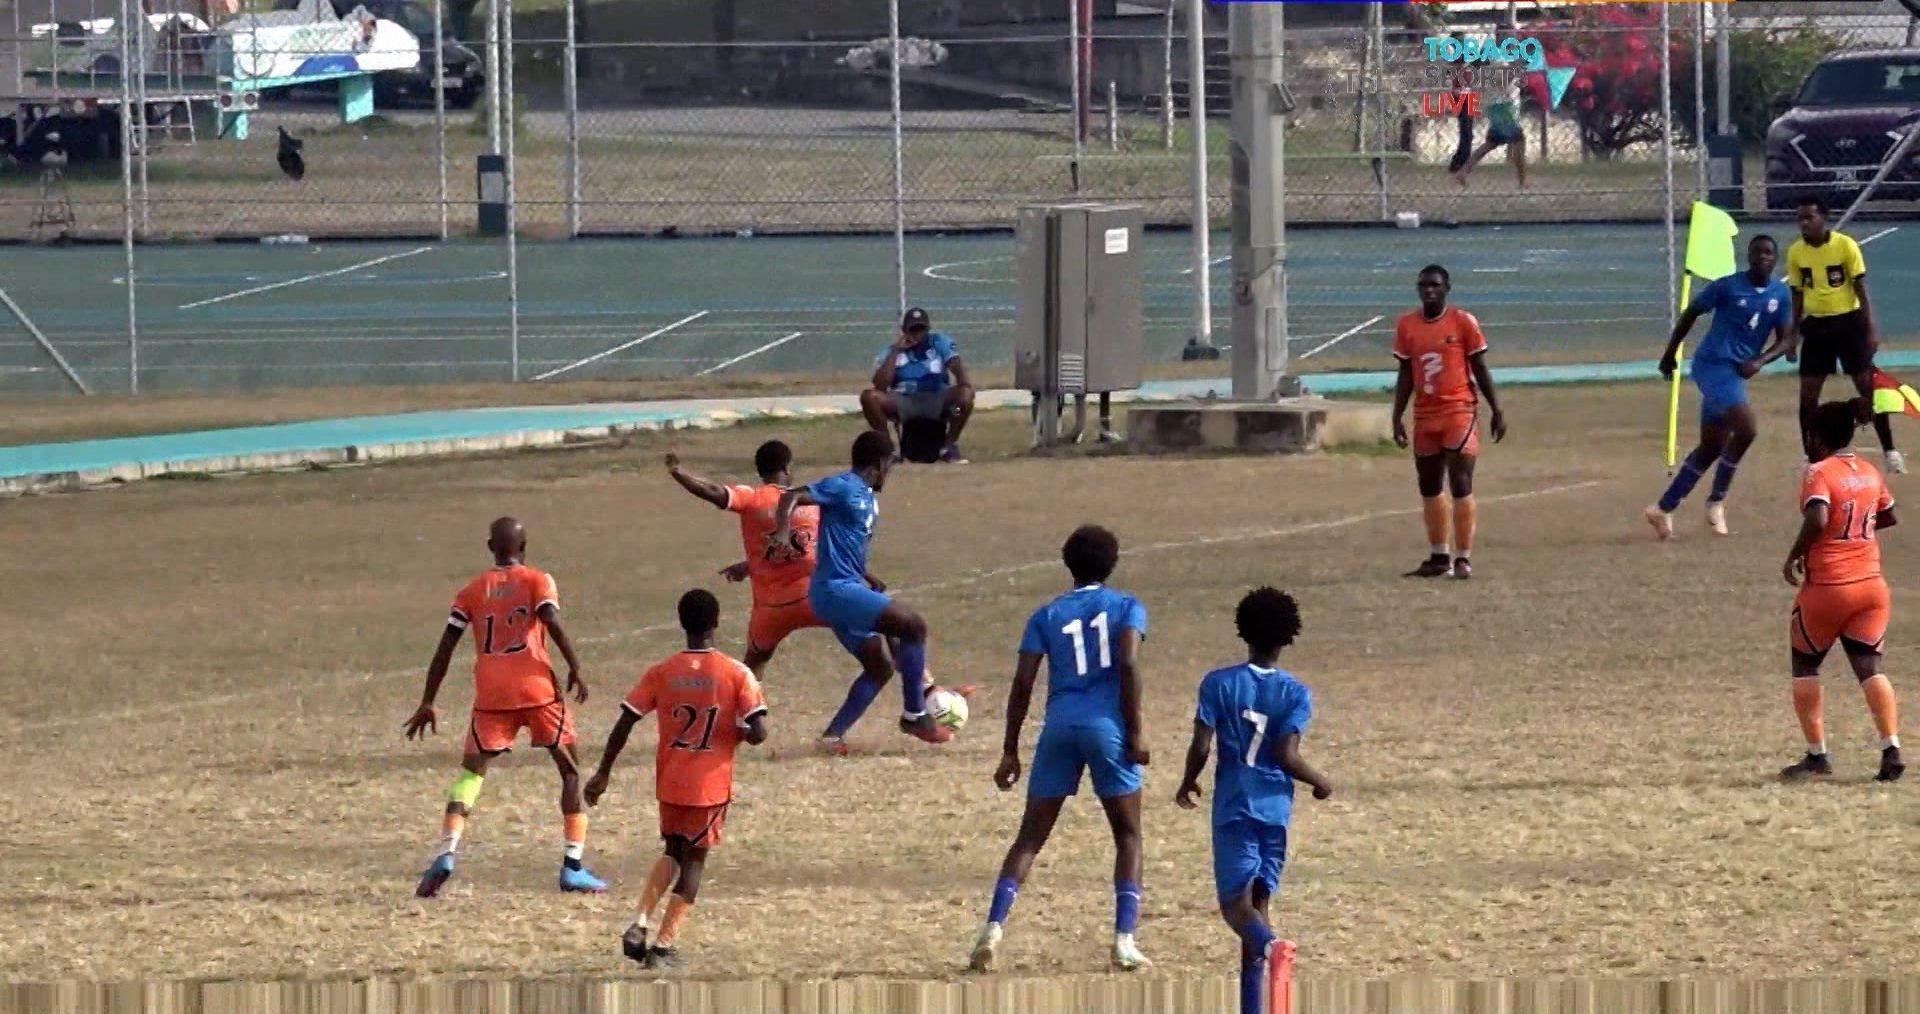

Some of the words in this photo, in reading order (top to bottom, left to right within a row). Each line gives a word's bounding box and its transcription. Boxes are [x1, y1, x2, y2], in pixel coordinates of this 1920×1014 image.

[1747, 312, 1760, 330] 4
[480, 605, 529, 656] 12
[1061, 611, 1112, 676] 11
[668, 703, 720, 752] 21
[1241, 709, 1268, 767] 7
